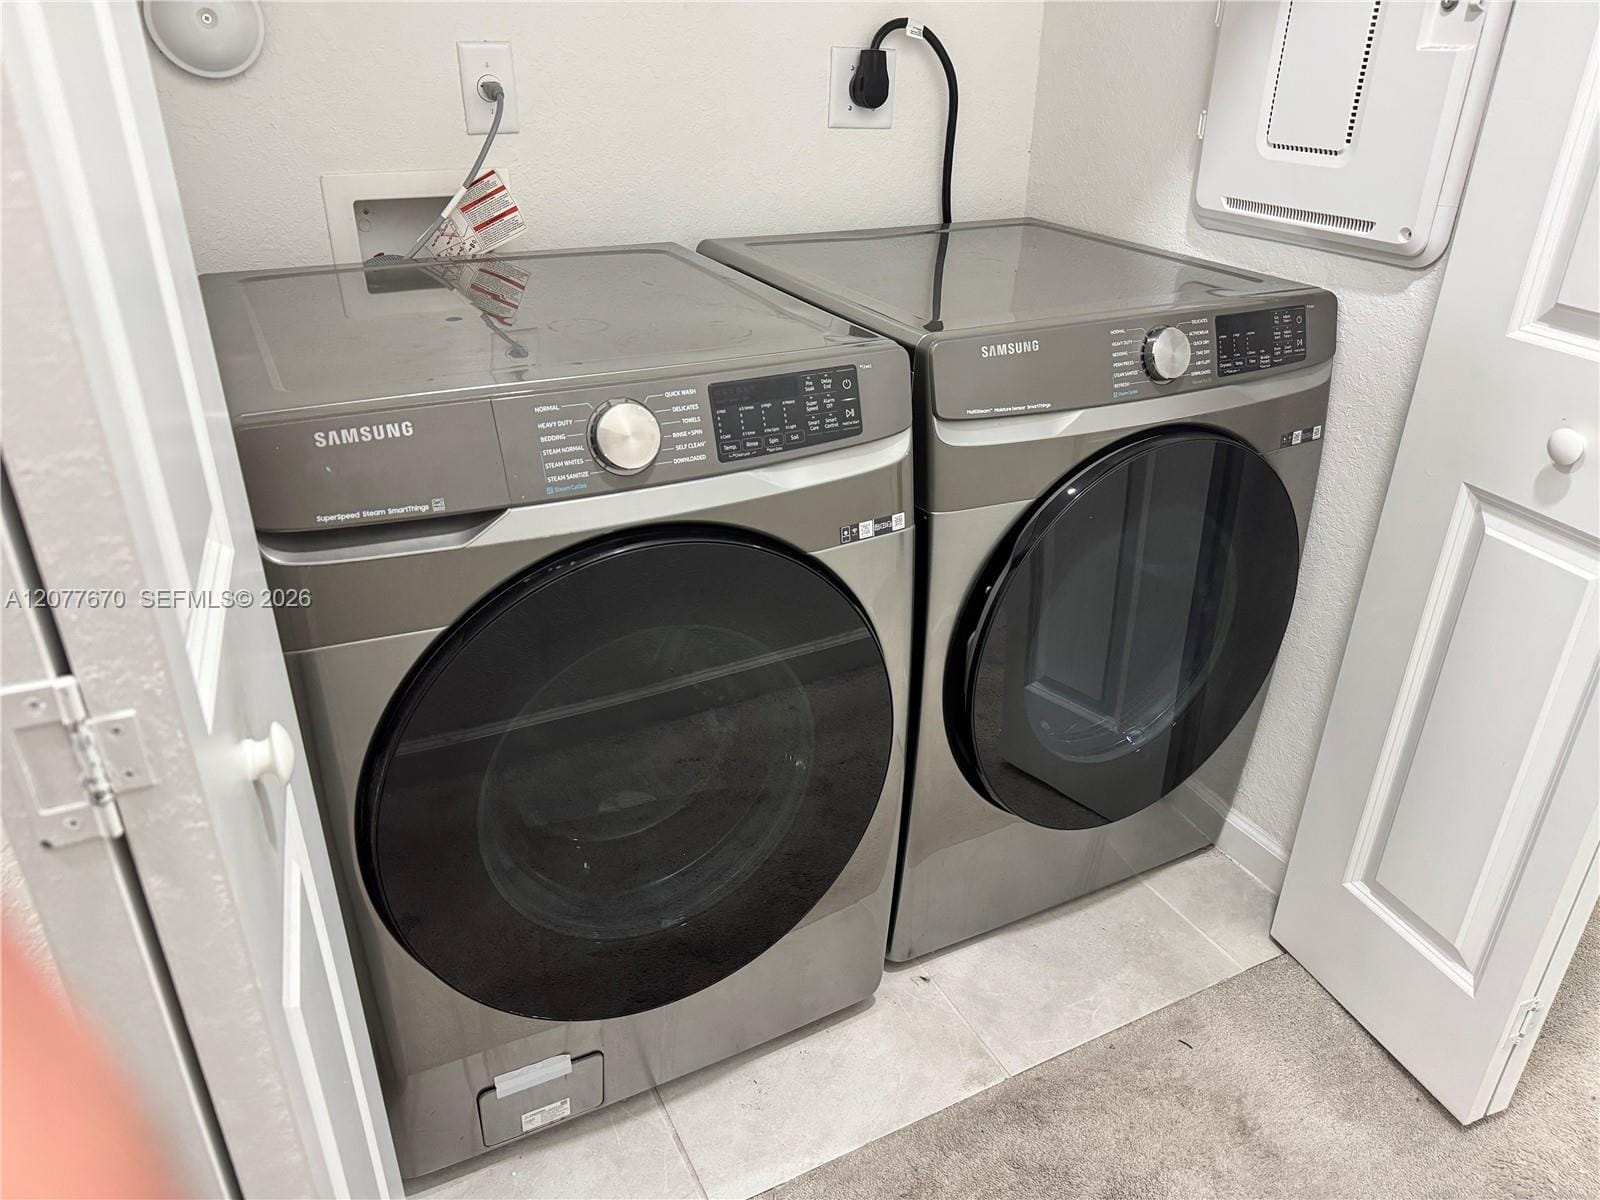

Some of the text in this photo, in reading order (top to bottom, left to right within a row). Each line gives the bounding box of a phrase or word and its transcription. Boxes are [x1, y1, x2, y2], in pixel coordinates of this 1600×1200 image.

[981, 340, 1039, 358] SAMSUNG
[534, 405, 560, 413] NORMAL
[672, 403, 700, 413] DELICATES
[537, 419, 573, 429] HEAVY DUTY
[682, 416, 701, 424] TOWELS
[313, 420, 414, 448] SAMSUNG
[540, 434, 566, 443] BEDDING
[542, 445, 584, 456] STEAM NORMAL
[545, 459, 584, 469] STEAM WHITES
[673, 454, 707, 464] DOWNLOADED
[547, 471, 589, 483] STEAM SANITIZE
[316, 511, 360, 523] SuperSpeed
[362, 509, 386, 518] Steam
[388, 503, 429, 514] SmartThings
